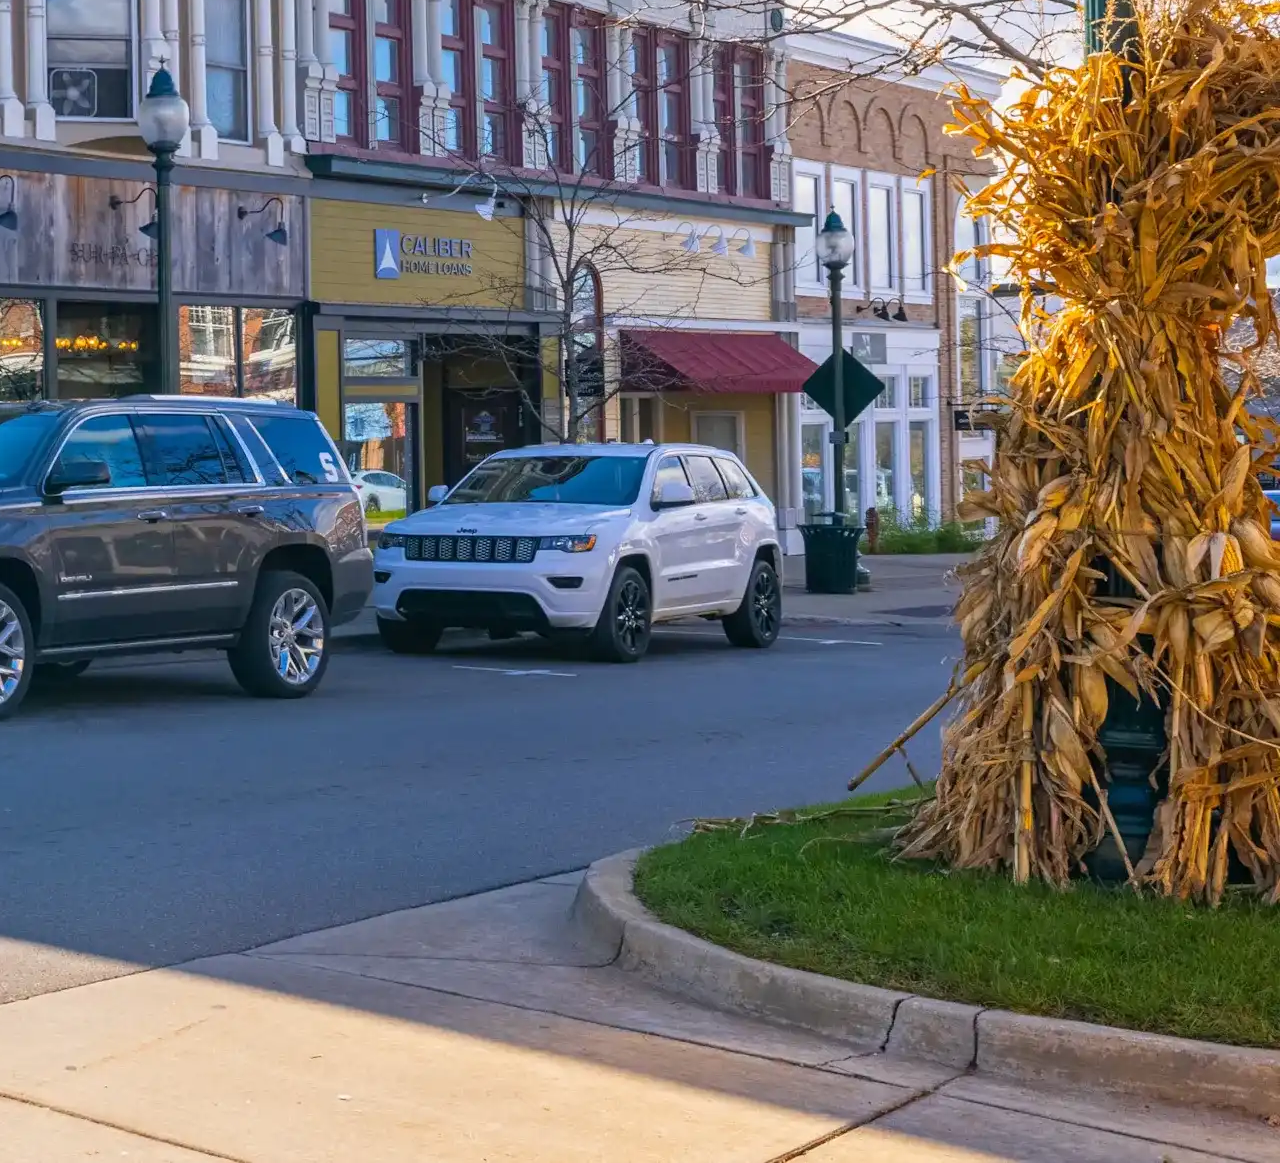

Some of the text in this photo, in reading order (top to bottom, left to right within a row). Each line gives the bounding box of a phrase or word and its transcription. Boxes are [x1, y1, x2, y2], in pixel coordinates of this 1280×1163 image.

[400, 234, 472, 258] CALIBER
[401, 259, 473, 275] HOME LOANS
[319, 452, 339, 482] S
